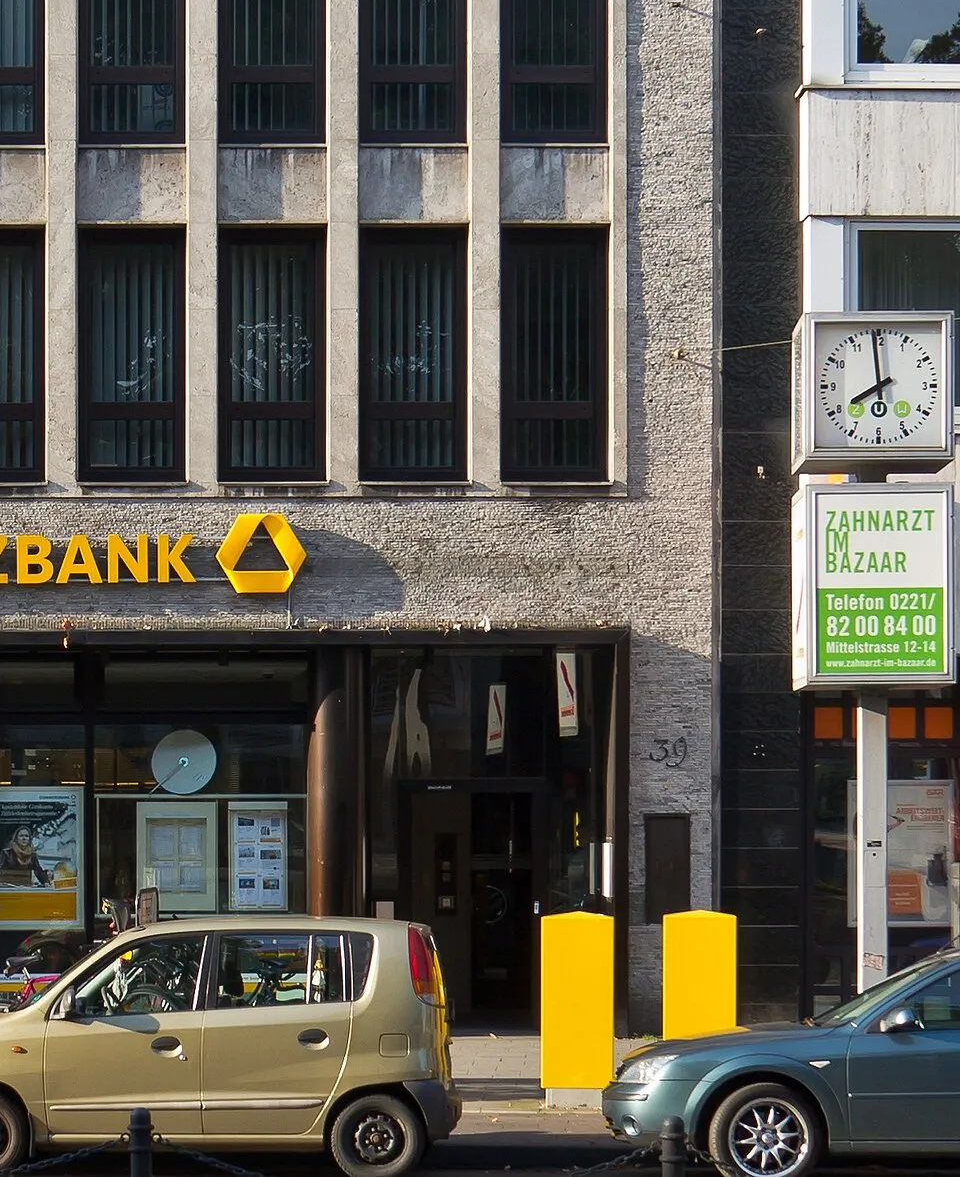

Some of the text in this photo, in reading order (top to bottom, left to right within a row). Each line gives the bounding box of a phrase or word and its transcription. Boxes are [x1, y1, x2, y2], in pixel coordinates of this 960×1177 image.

[852, 343, 862, 352] 11
[899, 343, 905, 352] 1
[835, 360, 845, 369] 10
[916, 359, 922, 369] 2
[830, 382, 837, 392] 9
[922, 381, 928, 391] 3
[836, 404, 842, 414] 8
[915, 404, 922, 413] 4
[853, 421, 859, 430] 7
[899, 420, 905, 430] 5
[876, 427, 882, 436] 6
[825, 509, 936, 532] ZAHNARZT
[825, 529, 849, 553] IM
[825, 551, 907, 573] BAZAAR
[825, 592, 936, 611] Telefon 0221/
[826, 614, 937, 637] 82 00 84 00
[825, 640, 937, 654] Mittelstrasse 12-14
[825, 658, 937, 668] www.zahnarzt-im-bazaar.de
[649, 736, 688, 768] 39
